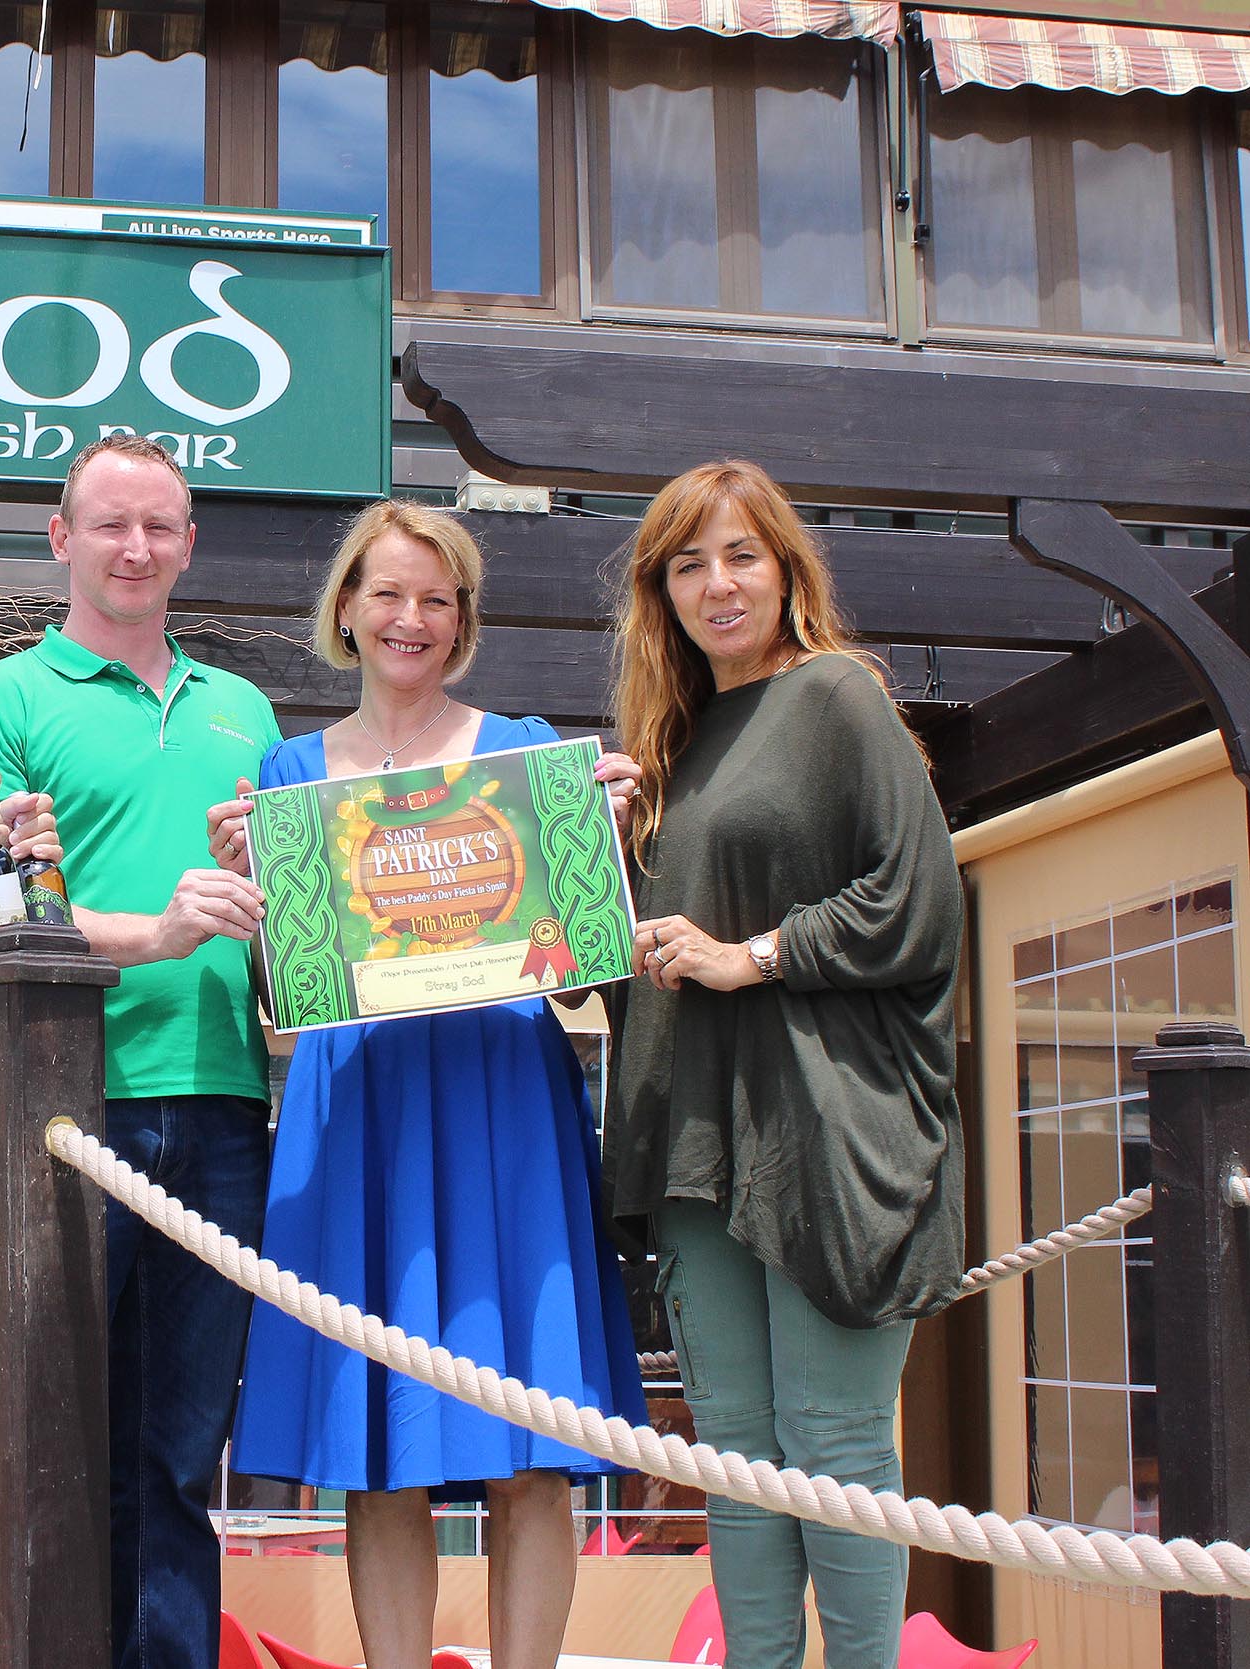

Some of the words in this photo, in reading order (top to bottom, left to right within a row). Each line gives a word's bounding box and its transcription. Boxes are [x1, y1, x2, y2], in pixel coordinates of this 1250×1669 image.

[384, 826, 426, 846] SAINT
[429, 868, 458, 886] DAY
[375, 896, 391, 907] The
[392, 895, 406, 905] best
[438, 889, 453, 900] Day
[454, 886, 476, 898] Fiesta
[477, 885, 485, 894] in
[485, 880, 507, 893] Spain
[410, 914, 437, 934] 17th
[439, 909, 481, 931] March
[440, 932, 455, 943] 2019
[424, 980, 458, 992] Stray
[462, 974, 486, 987] Sod
